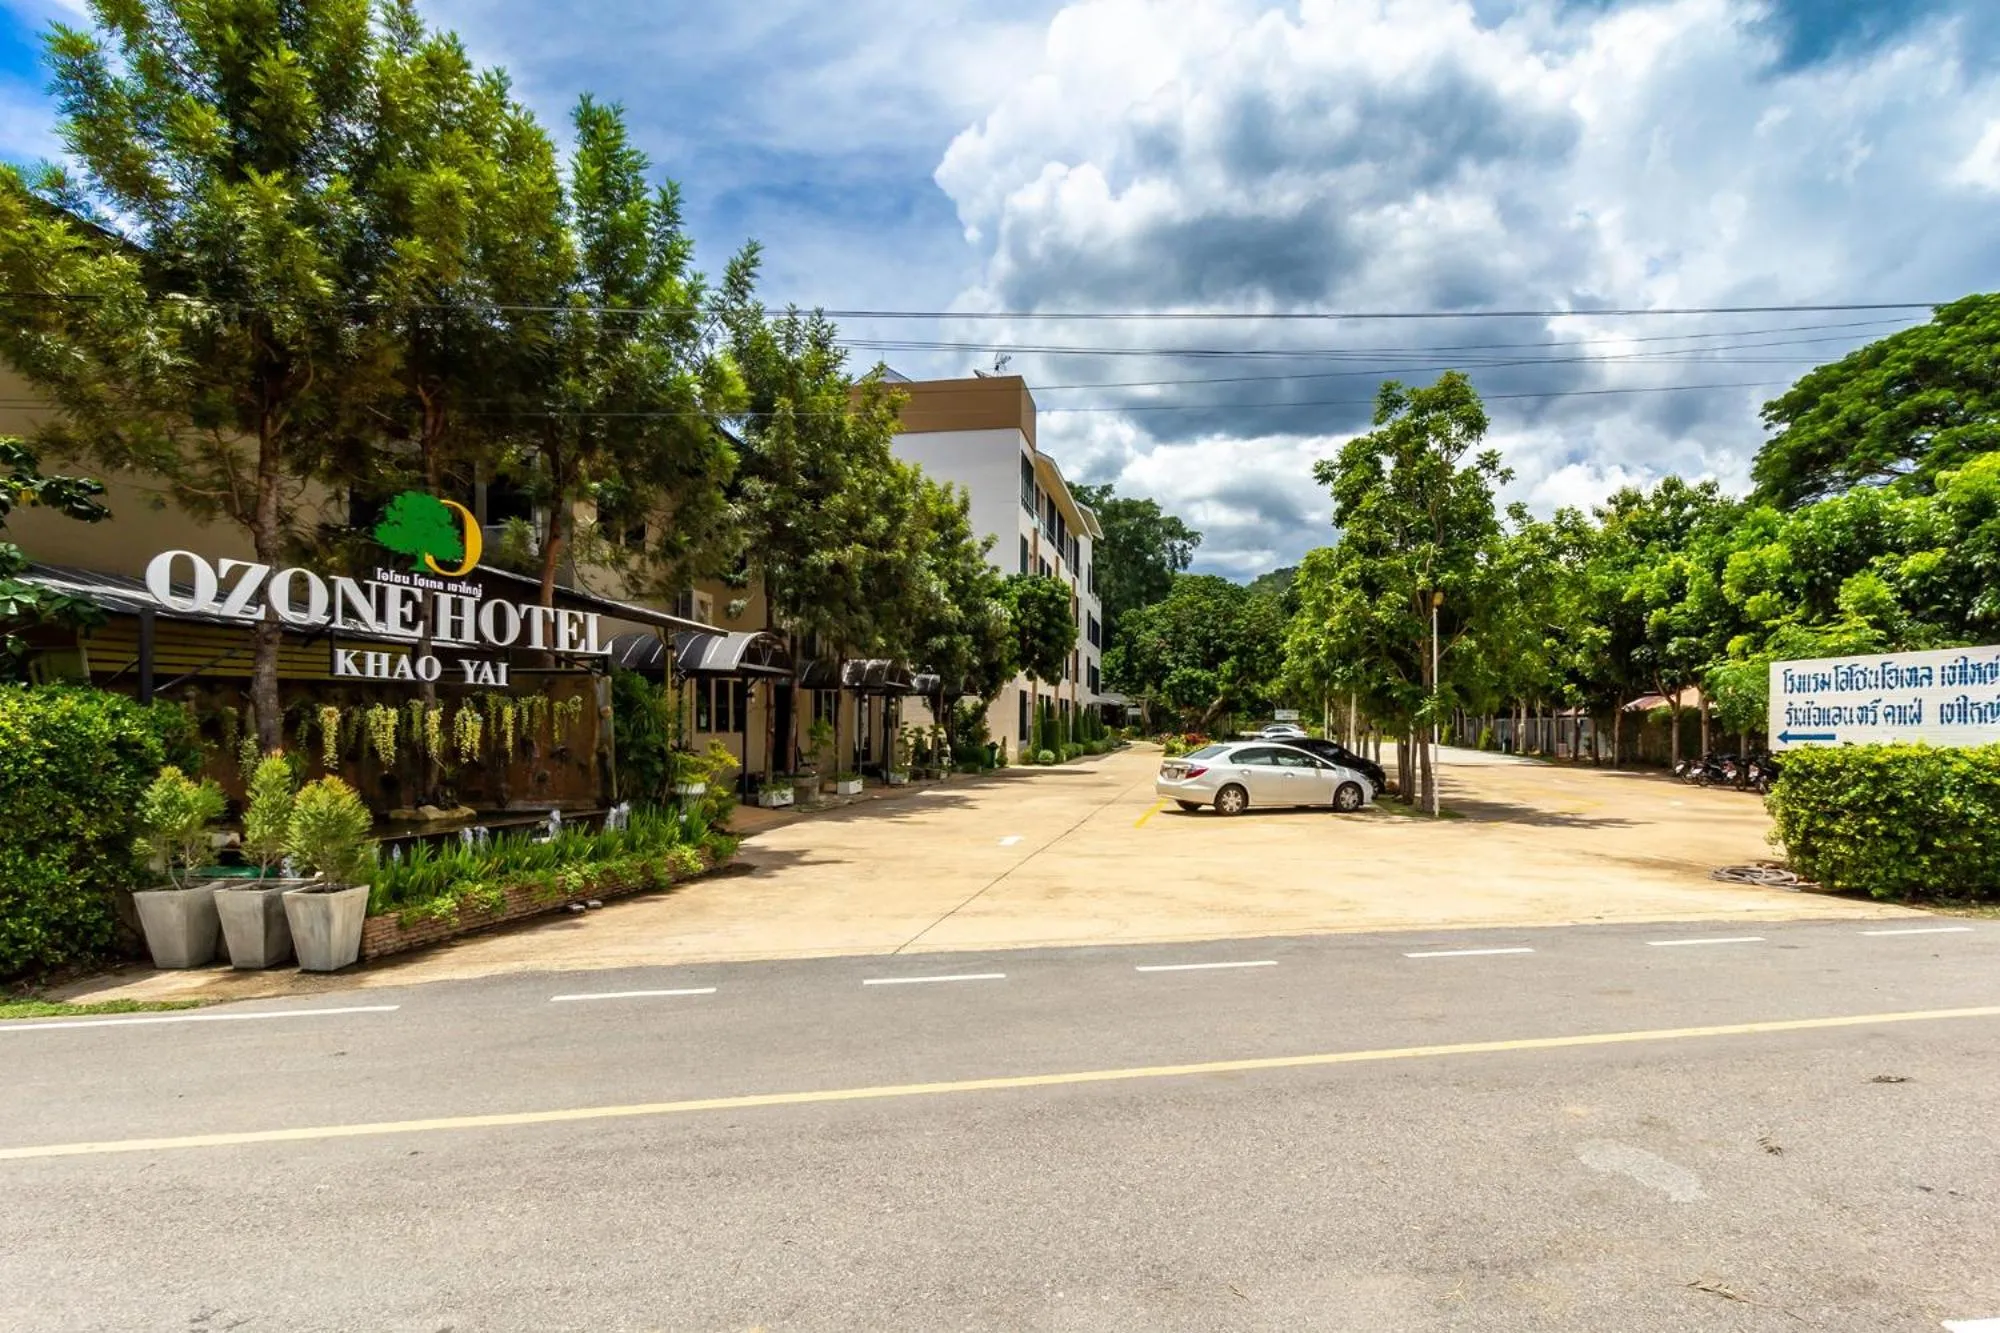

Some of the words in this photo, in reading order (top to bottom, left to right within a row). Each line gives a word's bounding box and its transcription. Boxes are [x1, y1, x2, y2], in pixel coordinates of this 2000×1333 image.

[376, 567, 410, 584] โอโซน
[447, 581, 483, 598] เขาใหญ่
[145, 550, 424, 638] OZONE
[431, 592, 613, 655] HOTEL
[335, 648, 442, 682] KHAO
[458, 659, 509, 686] YAI
